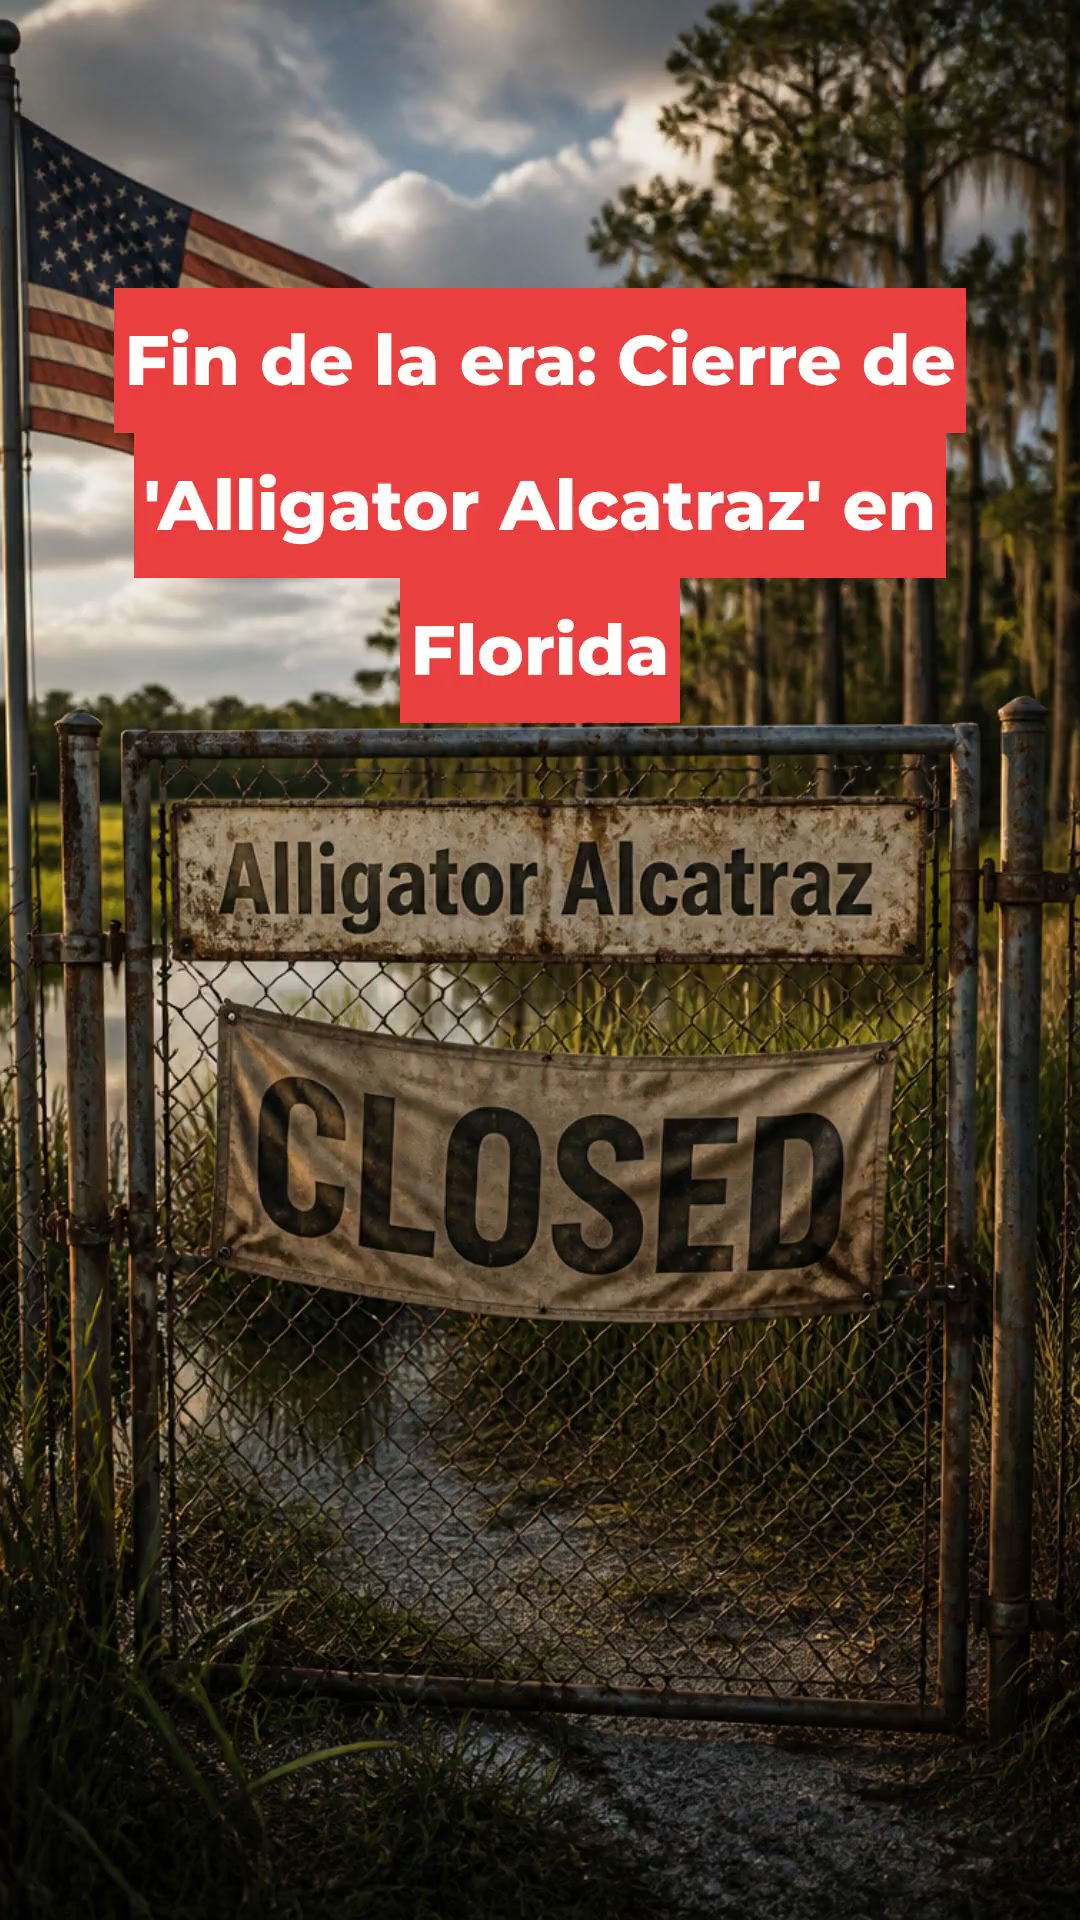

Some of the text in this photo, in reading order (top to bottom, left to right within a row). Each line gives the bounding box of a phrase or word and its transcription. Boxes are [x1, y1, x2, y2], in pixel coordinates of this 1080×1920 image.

[219, 840, 873, 934] Alligator Alcatraz
[257, 1076, 844, 1275] CLOSED
